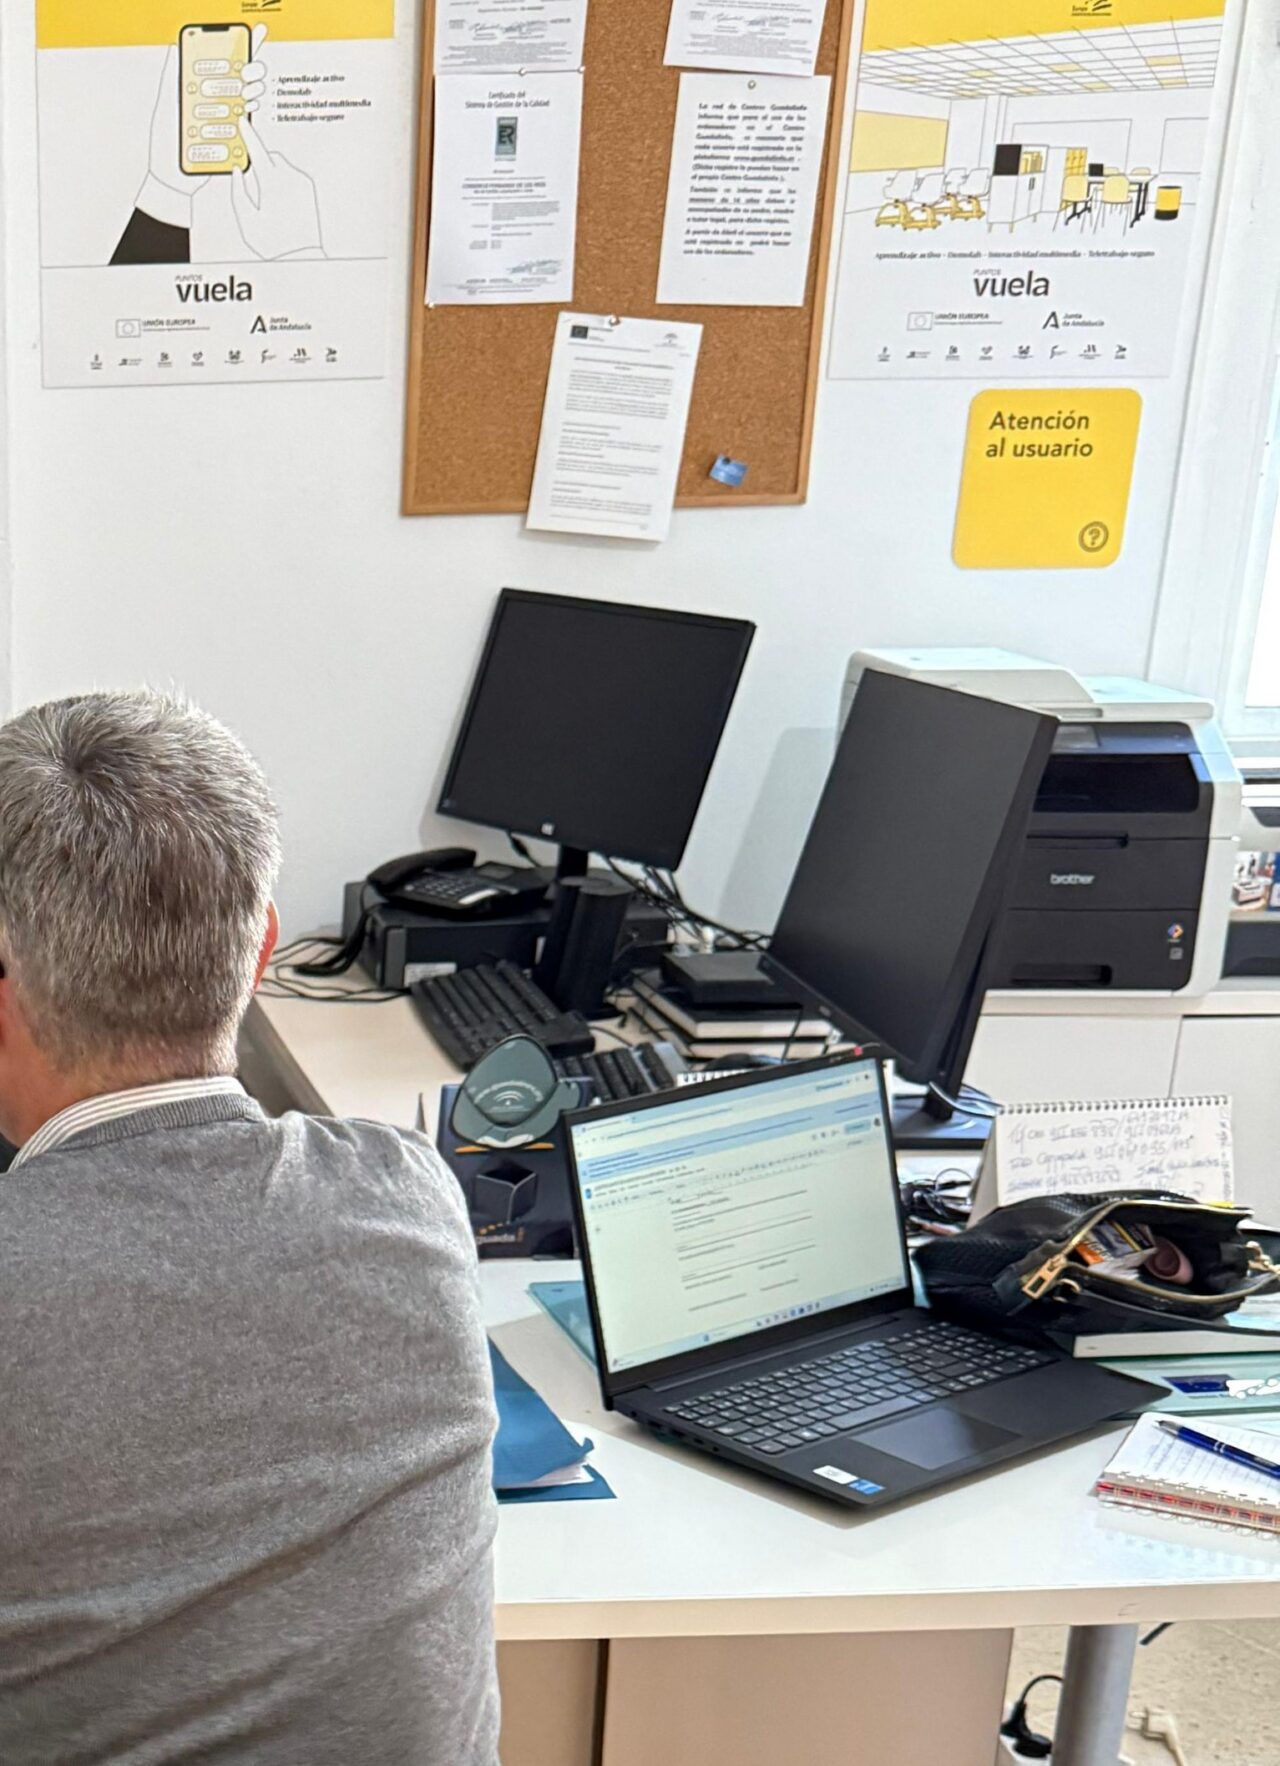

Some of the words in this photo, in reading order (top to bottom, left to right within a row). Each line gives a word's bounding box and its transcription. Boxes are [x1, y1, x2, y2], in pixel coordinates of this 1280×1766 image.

[176, 275, 253, 302] vuela
[974, 270, 1050, 297] vuela
[989, 409, 1090, 431] Atención
[985, 437, 1005, 458] al
[1013, 440, 1094, 458] usuario
[1050, 873, 1095, 886] brother
